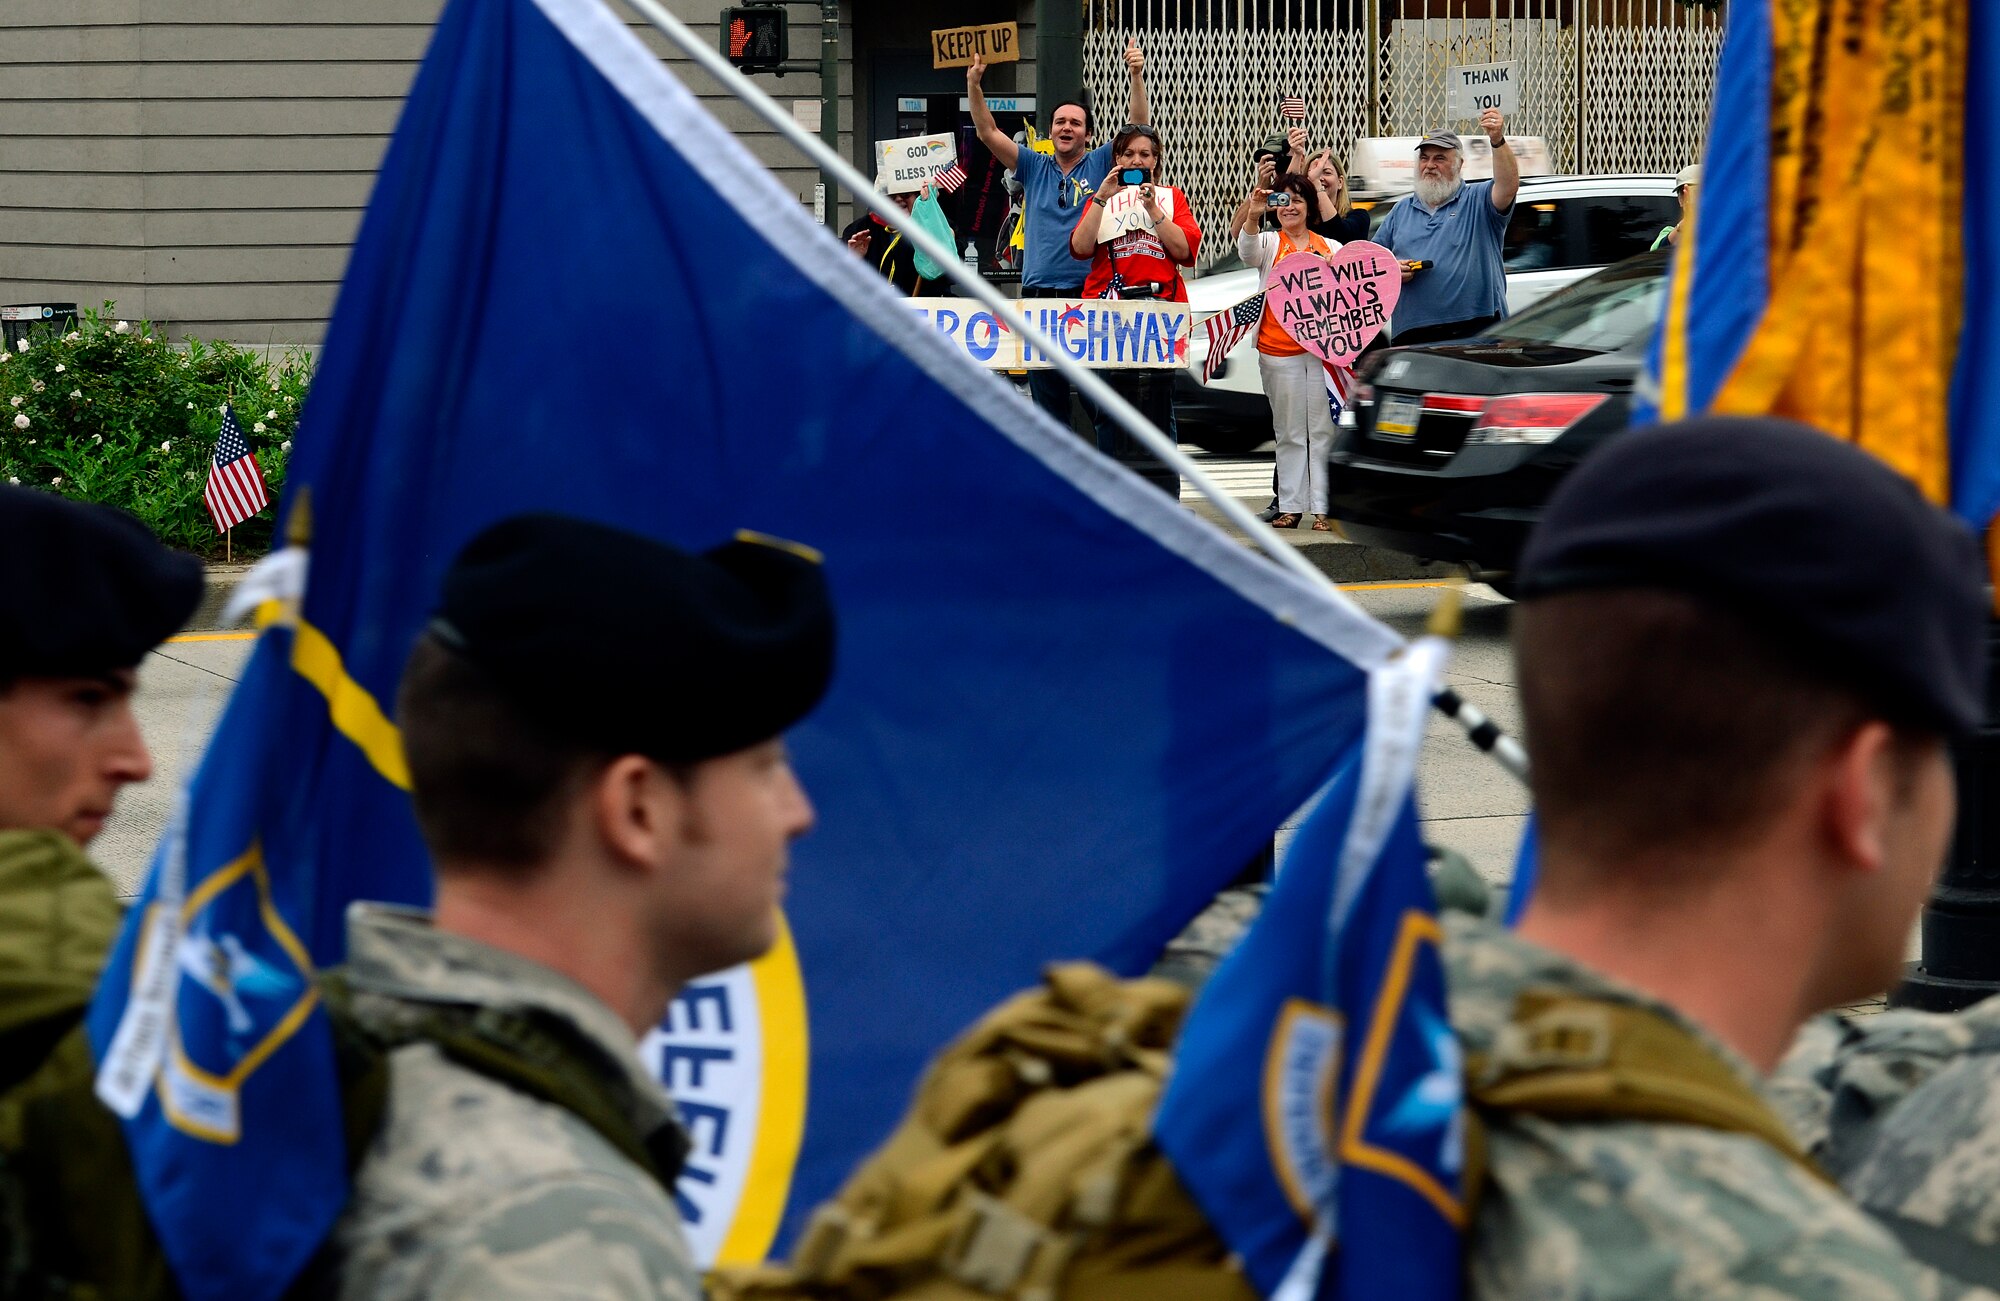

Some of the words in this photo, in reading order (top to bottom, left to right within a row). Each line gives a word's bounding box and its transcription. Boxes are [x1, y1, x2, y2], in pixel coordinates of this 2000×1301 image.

[992, 28, 1012, 53] UP
[1462, 67, 1509, 85] THANK
[985, 99, 1016, 110] ITAN
[1474, 94, 1501, 109] YOU
[907, 145, 928, 158] GOD
[895, 166, 926, 181] BLESS
[1110, 190, 1168, 215] THAK
[1115, 212, 1155, 232] YOU
[1280, 266, 1323, 294] WE
[1330, 257, 1387, 285] WILL
[1283, 281, 1379, 323] ALWAYS
[1294, 303, 1387, 342] REMEMBER
[911, 309, 1000, 361] RO
[1024, 309, 1184, 363] HIGHWAY
[1316, 331, 1363, 359] YOU
